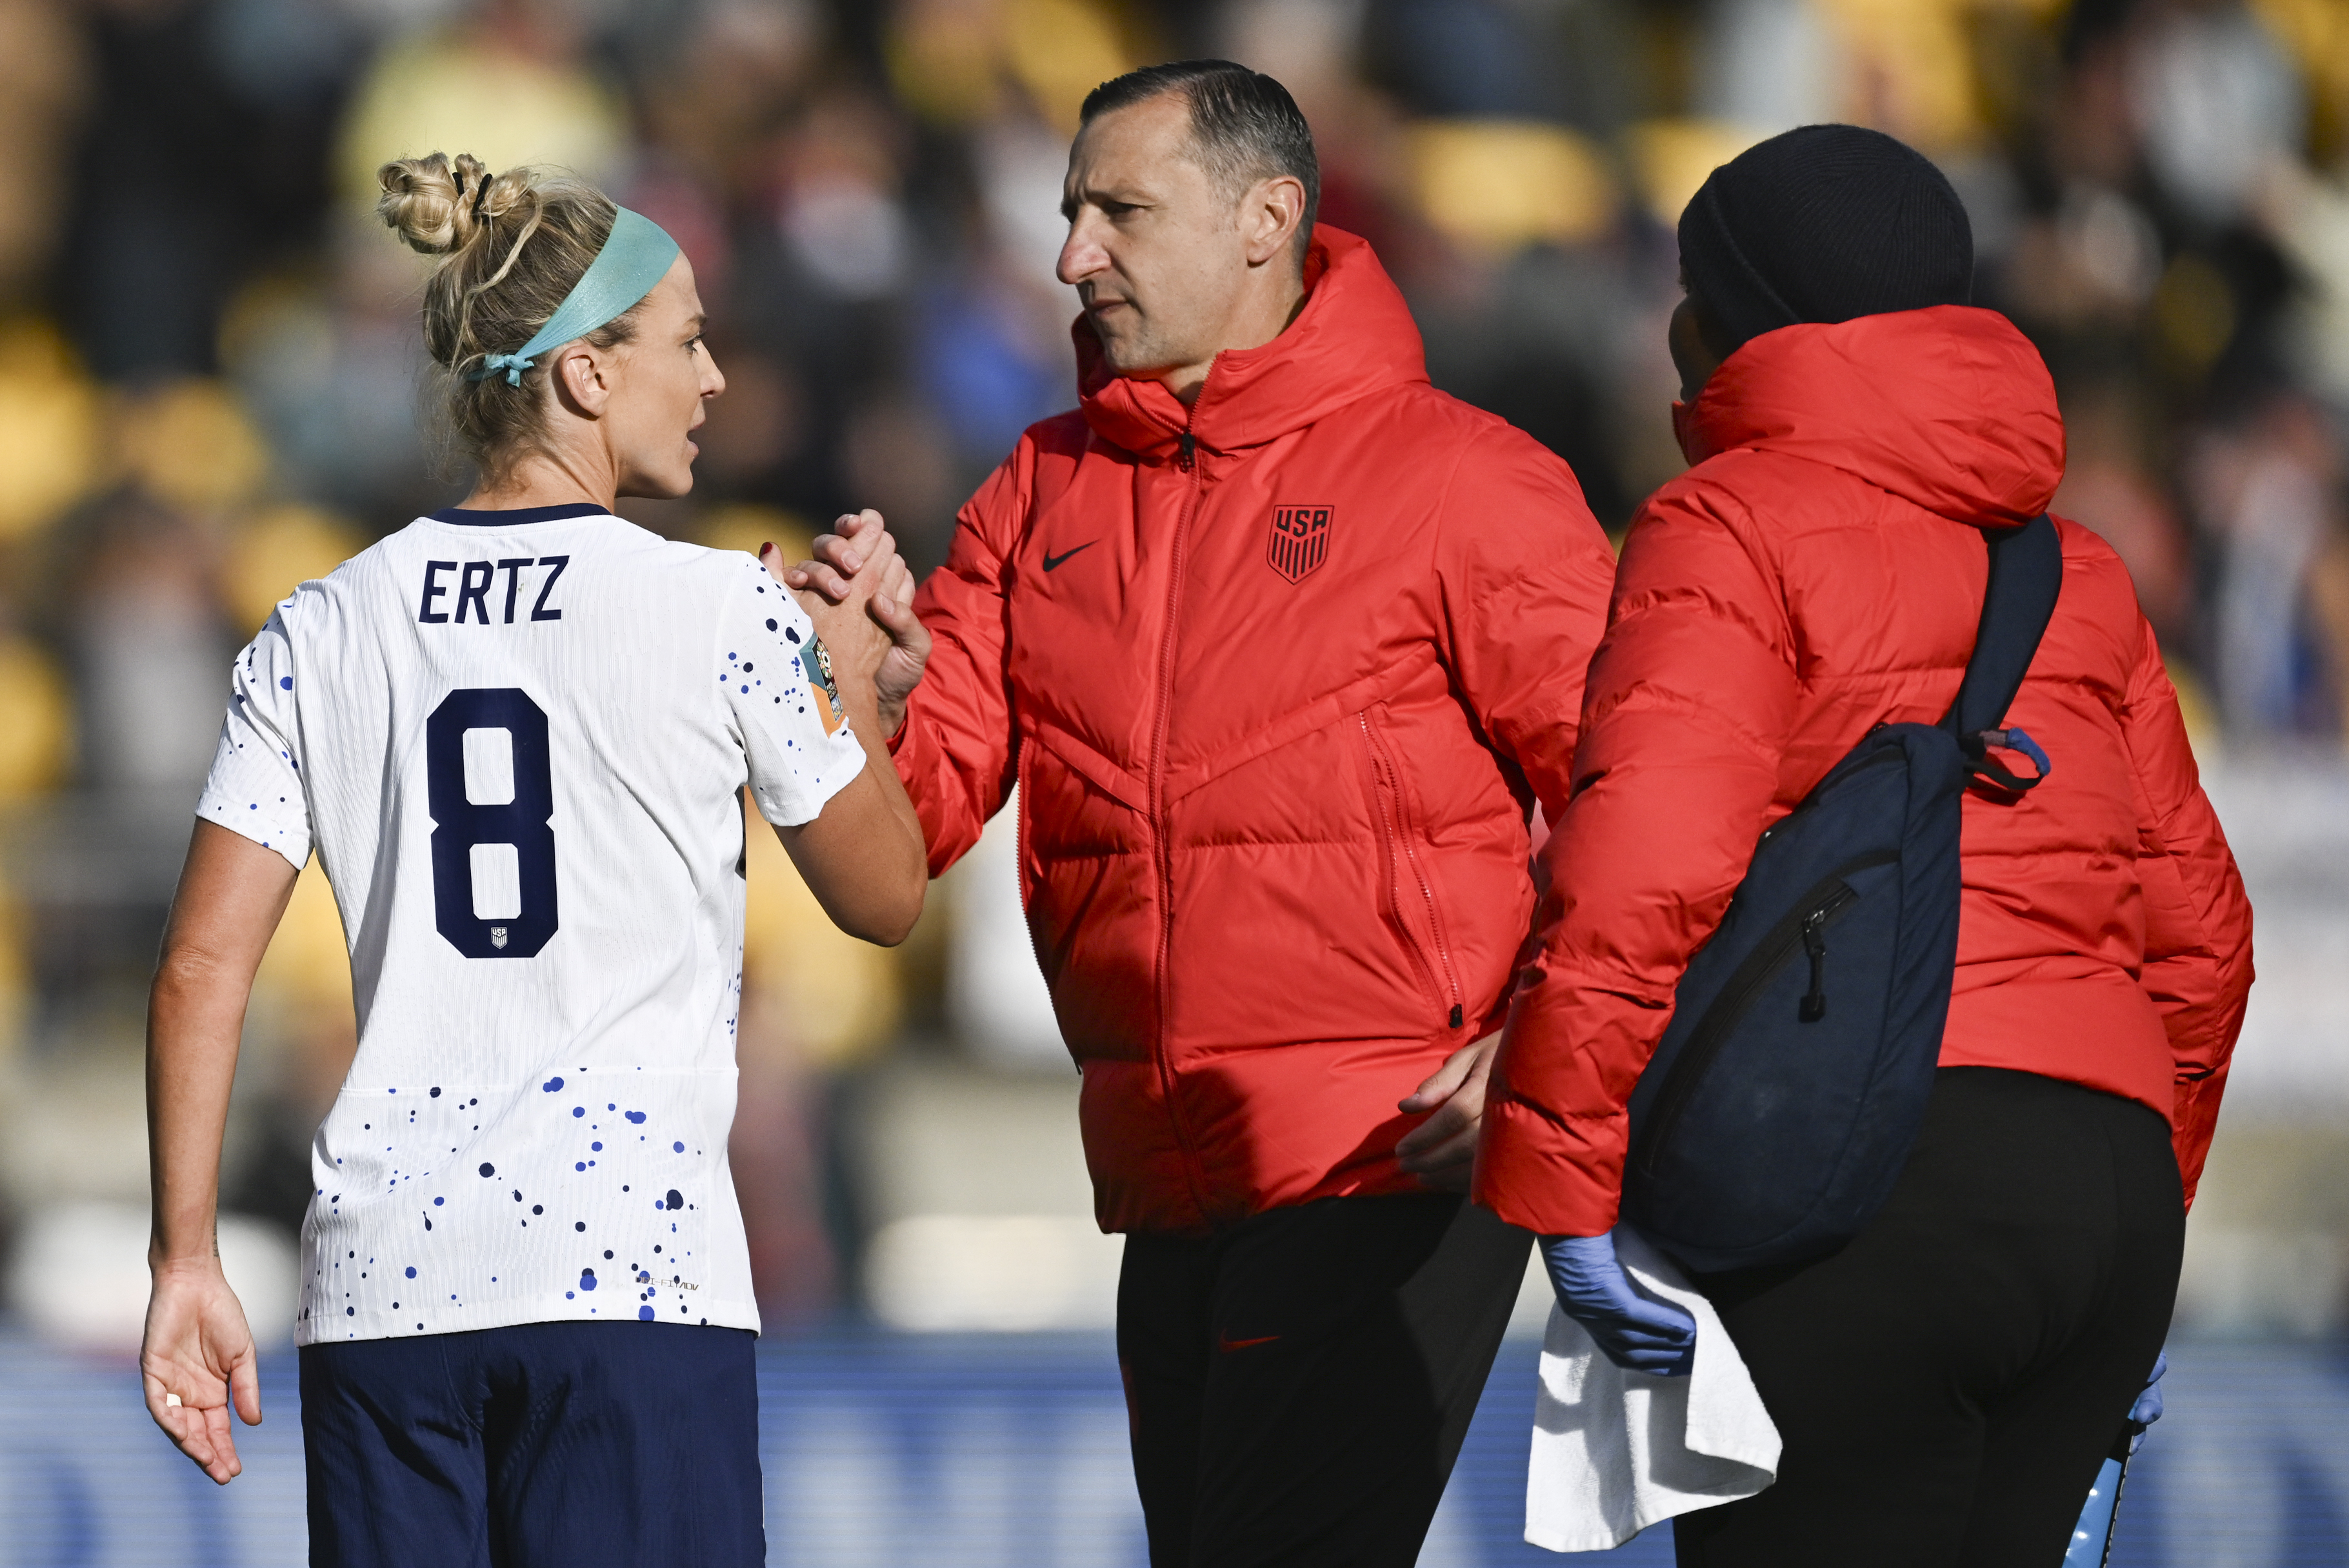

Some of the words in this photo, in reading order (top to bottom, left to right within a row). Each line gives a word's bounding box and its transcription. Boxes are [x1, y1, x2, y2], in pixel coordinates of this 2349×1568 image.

[1276, 510, 1328, 537] USA
[419, 555, 570, 624] ERTZ
[426, 688, 559, 958] 8
[492, 928, 506, 937] USA
